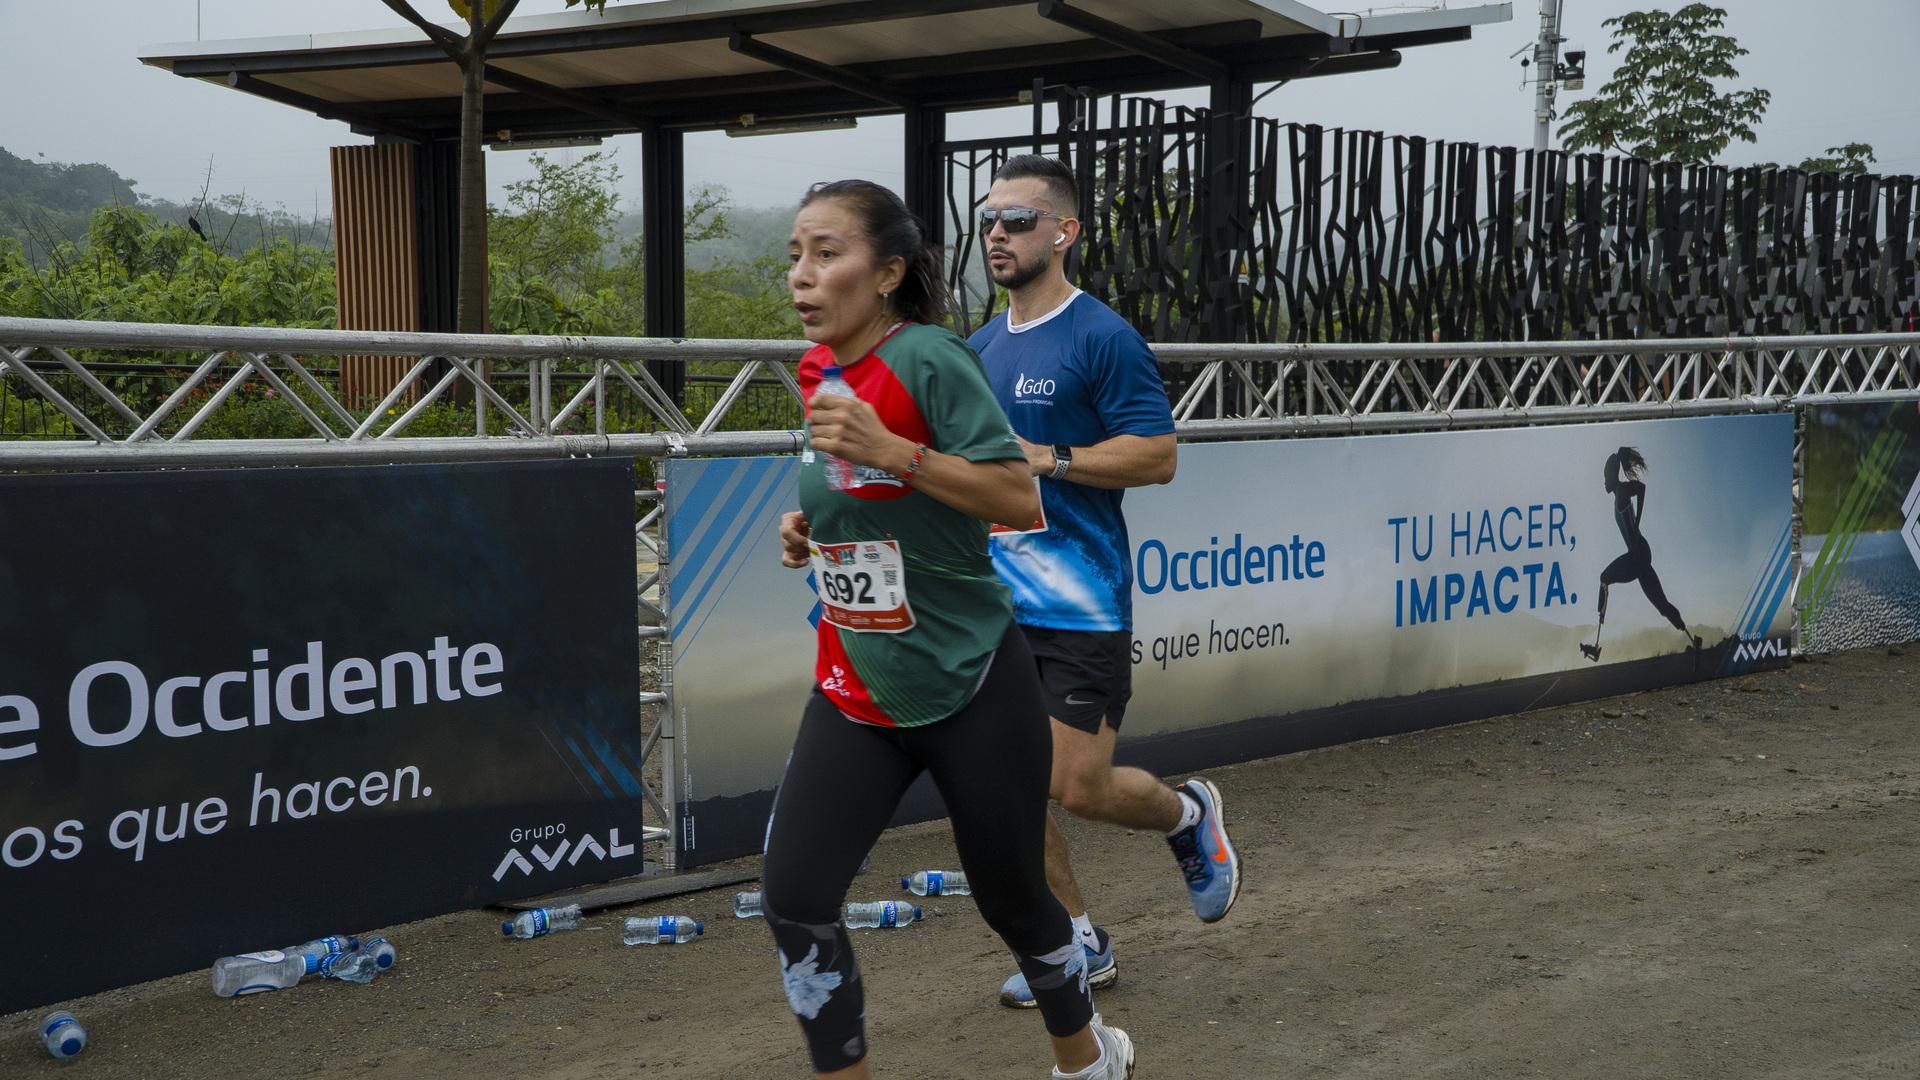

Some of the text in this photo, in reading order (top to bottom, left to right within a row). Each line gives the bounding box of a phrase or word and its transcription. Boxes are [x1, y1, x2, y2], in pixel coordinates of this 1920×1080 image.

[1022, 378, 1056, 396] GdO
[1387, 503, 1577, 563] TU HACER,
[823, 570, 876, 604] 692
[1136, 533, 1326, 595] Occidente
[1395, 562, 1578, 627] IMPACTA.
[1152, 633, 1200, 671] que
[1208, 618, 1291, 655] hacen.
[1733, 638, 1787, 663] AVAL
[1740, 632, 1762, 641] Grupo
[68, 635, 505, 748] Occidente
[108, 796, 229, 862] que
[249, 765, 434, 827] hacen.
[510, 822, 567, 844] Grupo
[491, 828, 635, 882] AVAL
